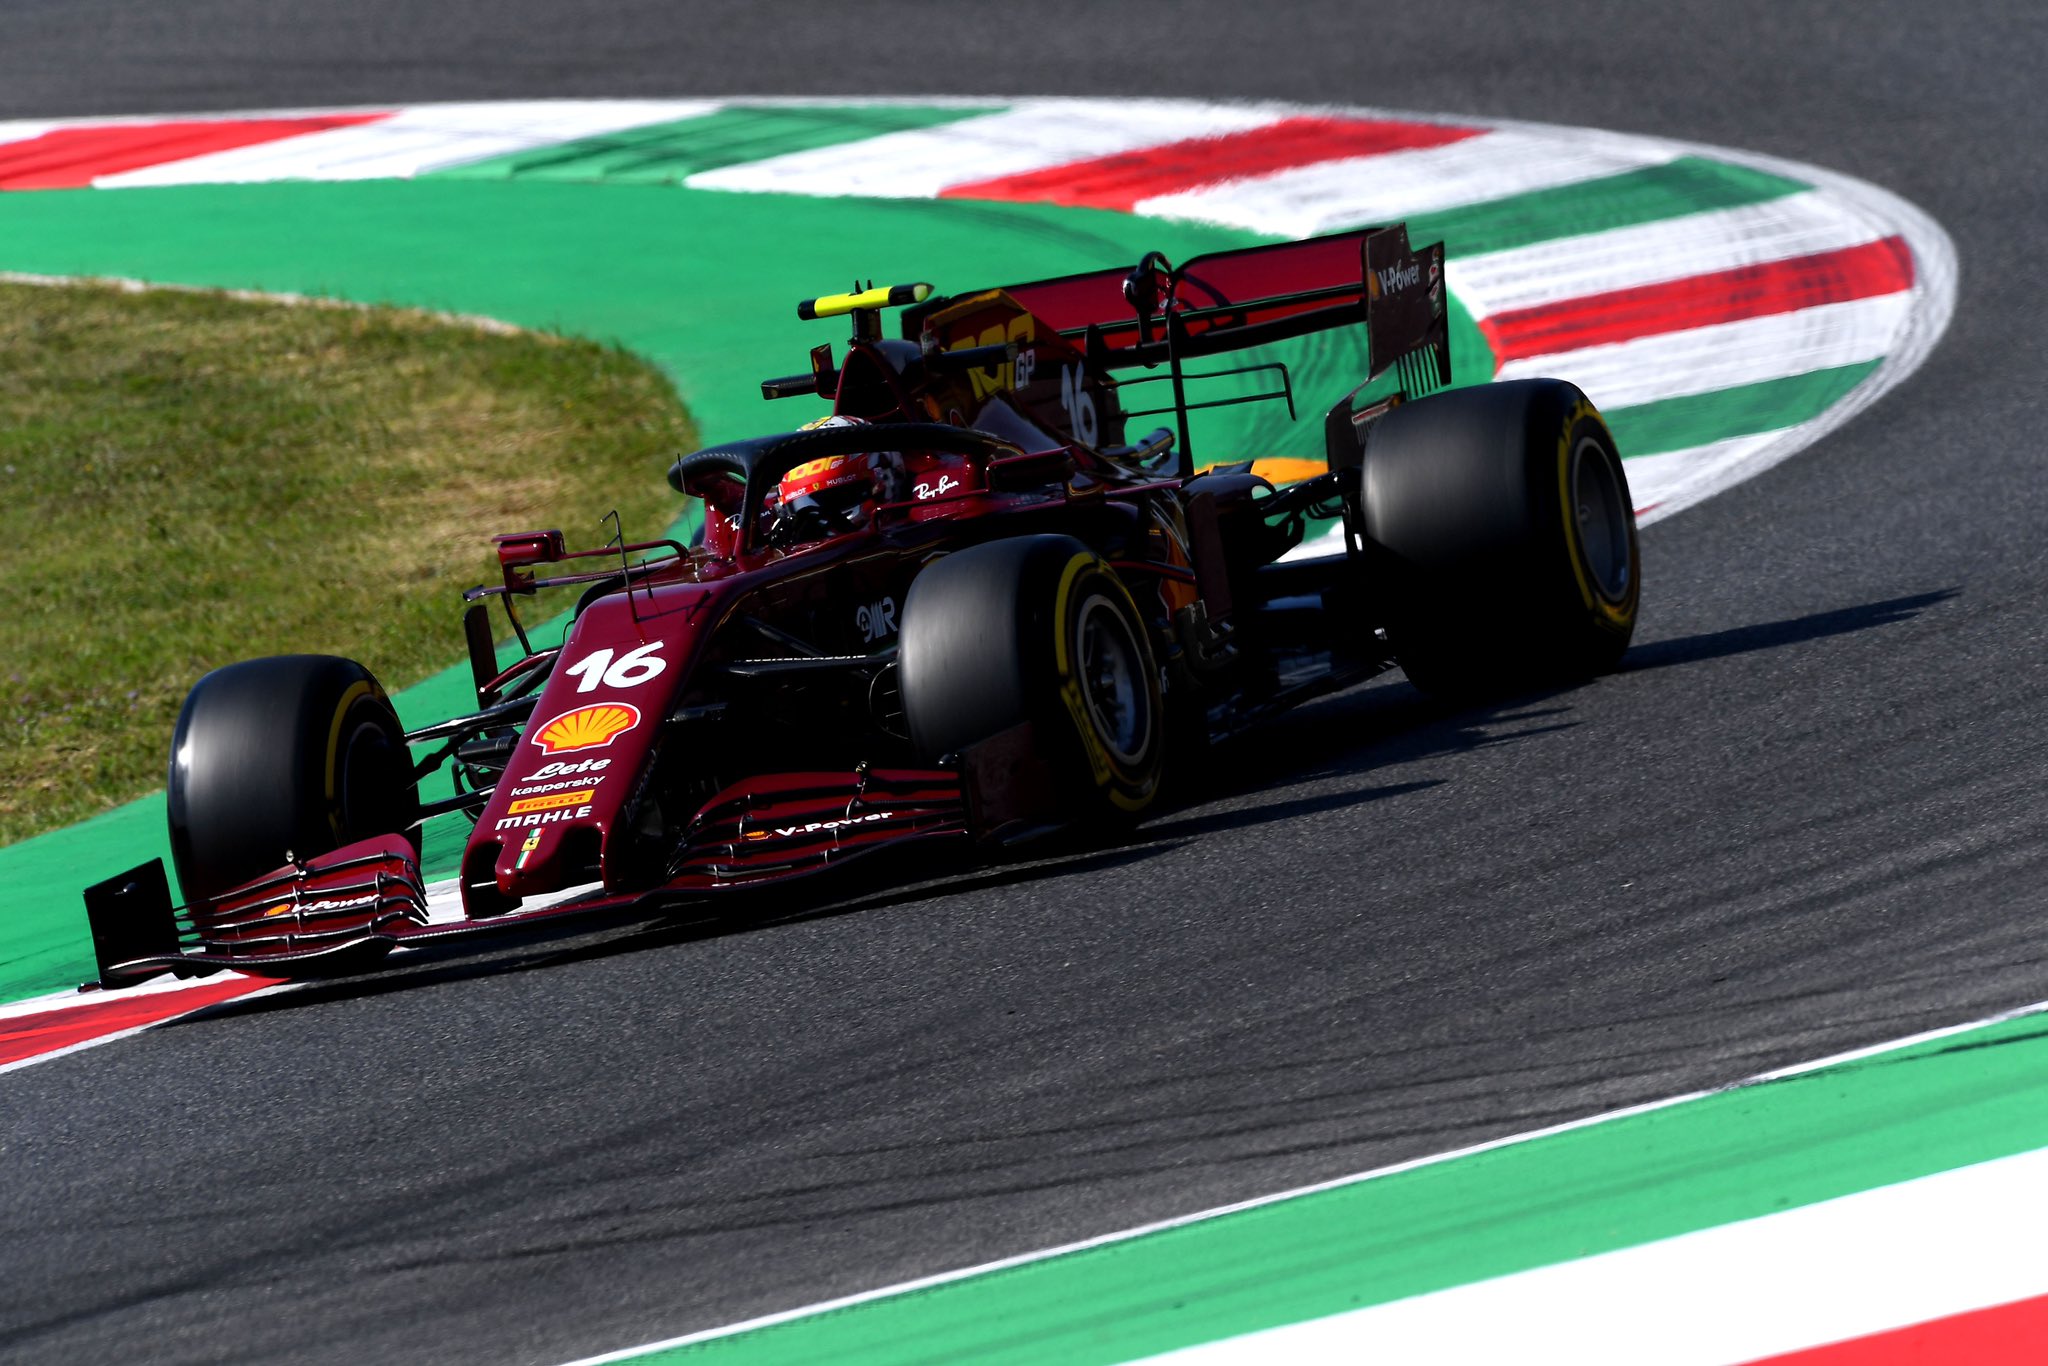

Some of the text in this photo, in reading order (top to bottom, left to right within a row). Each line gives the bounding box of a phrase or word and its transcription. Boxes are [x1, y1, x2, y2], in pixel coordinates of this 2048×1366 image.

[1377, 263, 1421, 296] V-Power
[1060, 360, 1098, 450] 16
[825, 473, 857, 487] HUBLOT
[911, 474, 960, 500] Ray-Ban
[565, 640, 667, 693] 16
[521, 758, 612, 782] Lete
[510, 775, 606, 797] kaspersky
[516, 793, 586, 810] PIRELLI
[494, 805, 593, 830] MAHLE
[775, 809, 893, 837] V-Power
[291, 893, 381, 913] V-Power
